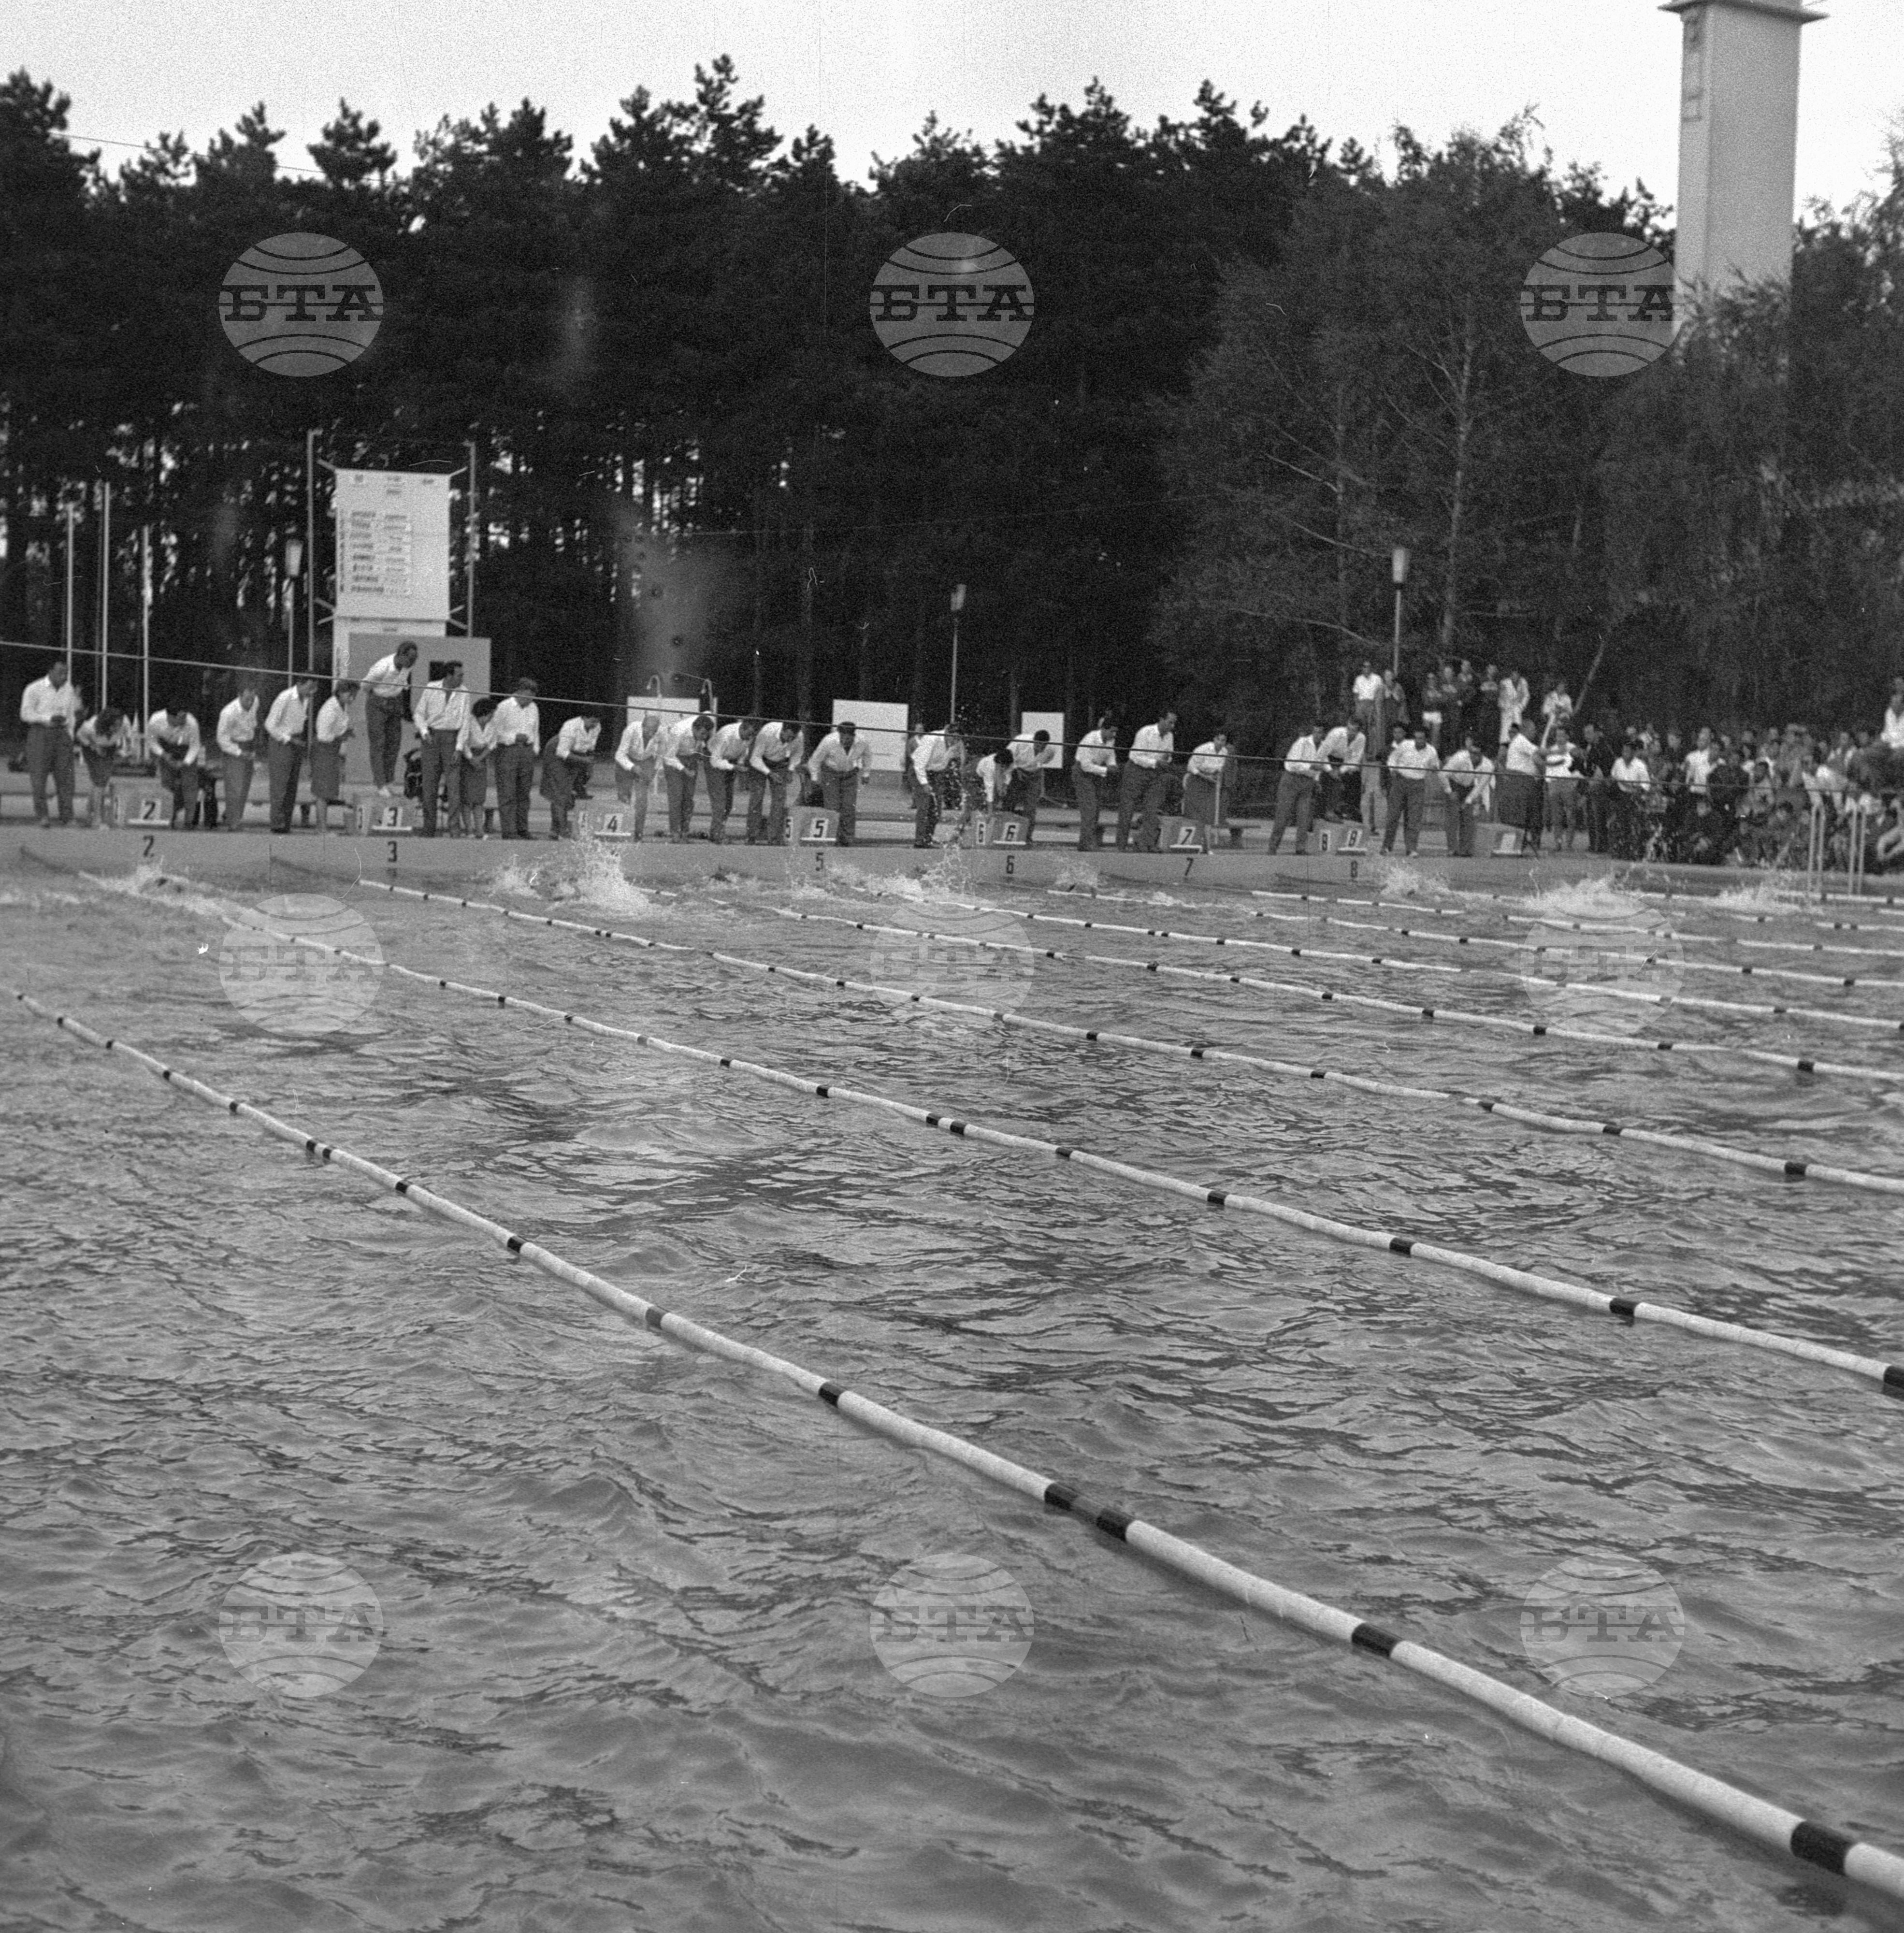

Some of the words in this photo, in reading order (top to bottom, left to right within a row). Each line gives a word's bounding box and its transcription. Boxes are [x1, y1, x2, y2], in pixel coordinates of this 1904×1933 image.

[144, 801, 156, 819] 2
[388, 807, 398, 826] 3
[607, 815, 617, 832] 4
[813, 820, 825, 837] 5
[1006, 824, 1016, 841] 6
[979, 823, 984, 843] 6
[1181, 828, 1193, 845] 7
[1348, 830, 1357, 846] 8
[143, 835, 154, 857] 2
[388, 841, 397, 862] 3
[1322, 834, 1328, 851] 8
[816, 852, 823, 871] 5
[1007, 855, 1015, 874] 6
[1185, 857, 1194, 876] 7
[1351, 861, 1358, 878] 8
